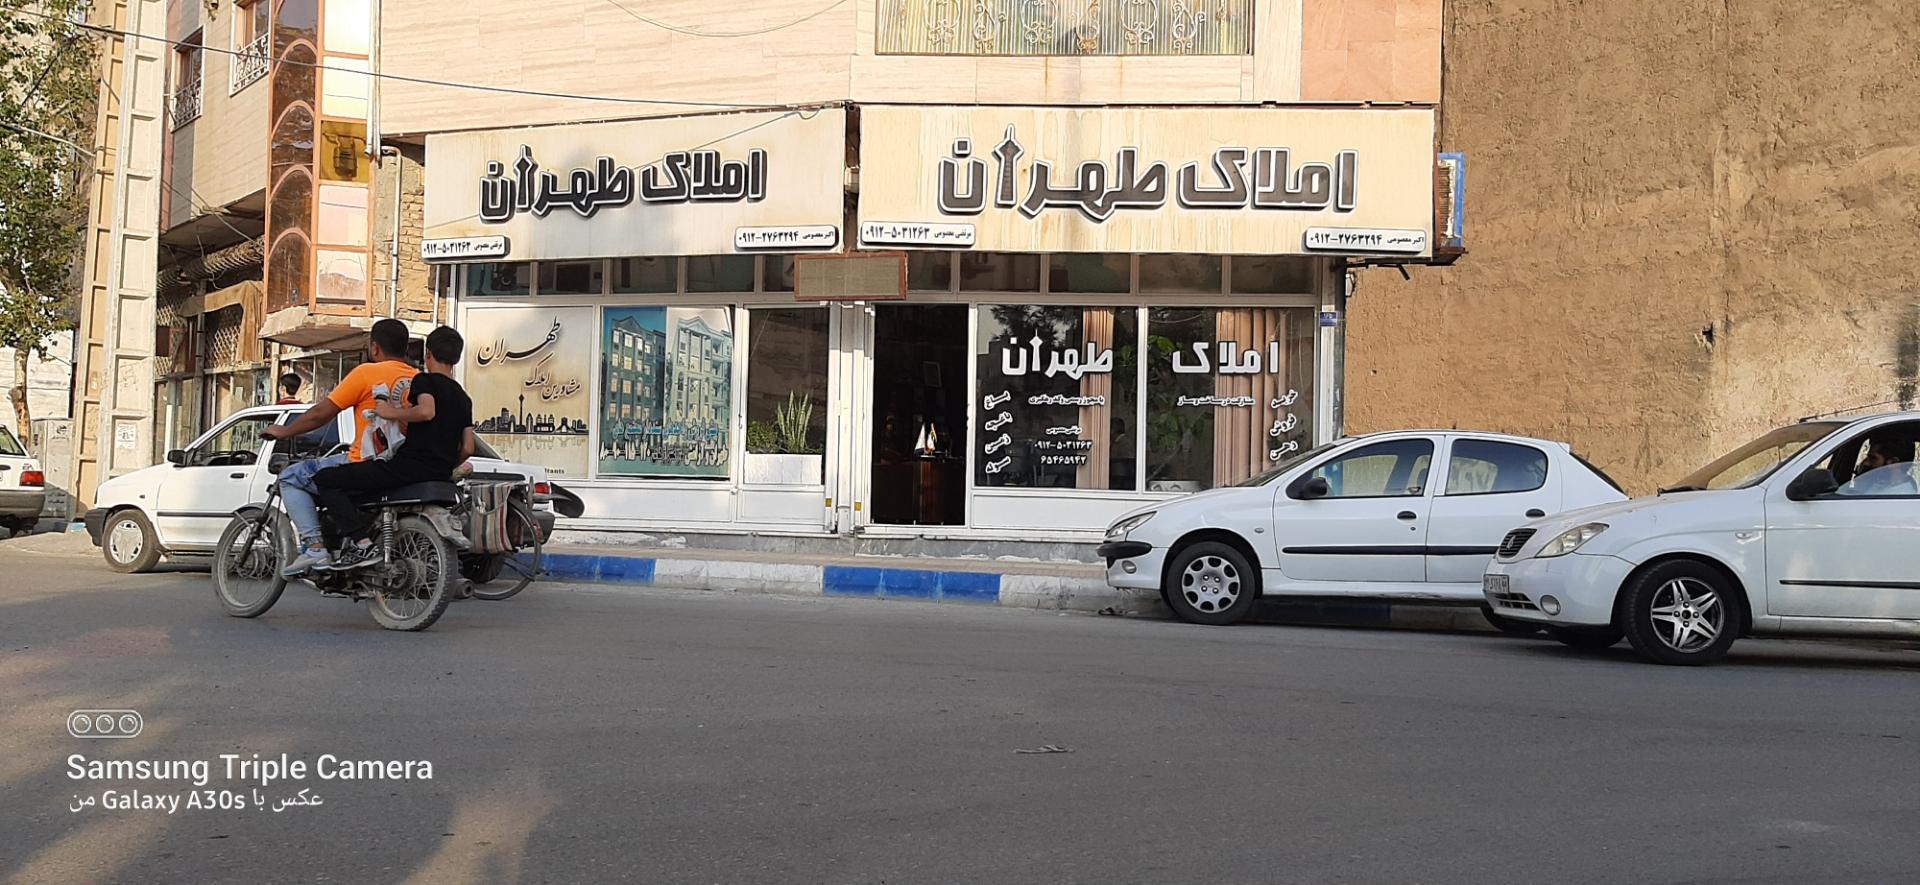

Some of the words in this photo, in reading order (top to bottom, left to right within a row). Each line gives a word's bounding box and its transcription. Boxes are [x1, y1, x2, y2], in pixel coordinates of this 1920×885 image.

[480, 144, 634, 223] طهران
[639, 148, 767, 203] املاک
[938, 123, 1169, 222] طهران
[1176, 146, 1359, 211] املاک
[476, 315, 561, 366] طهران
[1002, 328, 1113, 380] طهران
[525, 351, 554, 386] املاک
[1172, 341, 1278, 374] املاک
[542, 377, 582, 400] مشاورین
[984, 390, 1011, 410] باغ
[1271, 389, 1298, 408] خرید
[985, 411, 1013, 431] باغچه
[1270, 413, 1296, 436] فروش
[985, 433, 1011, 454] زمین
[1270, 440, 1298, 460] رهن
